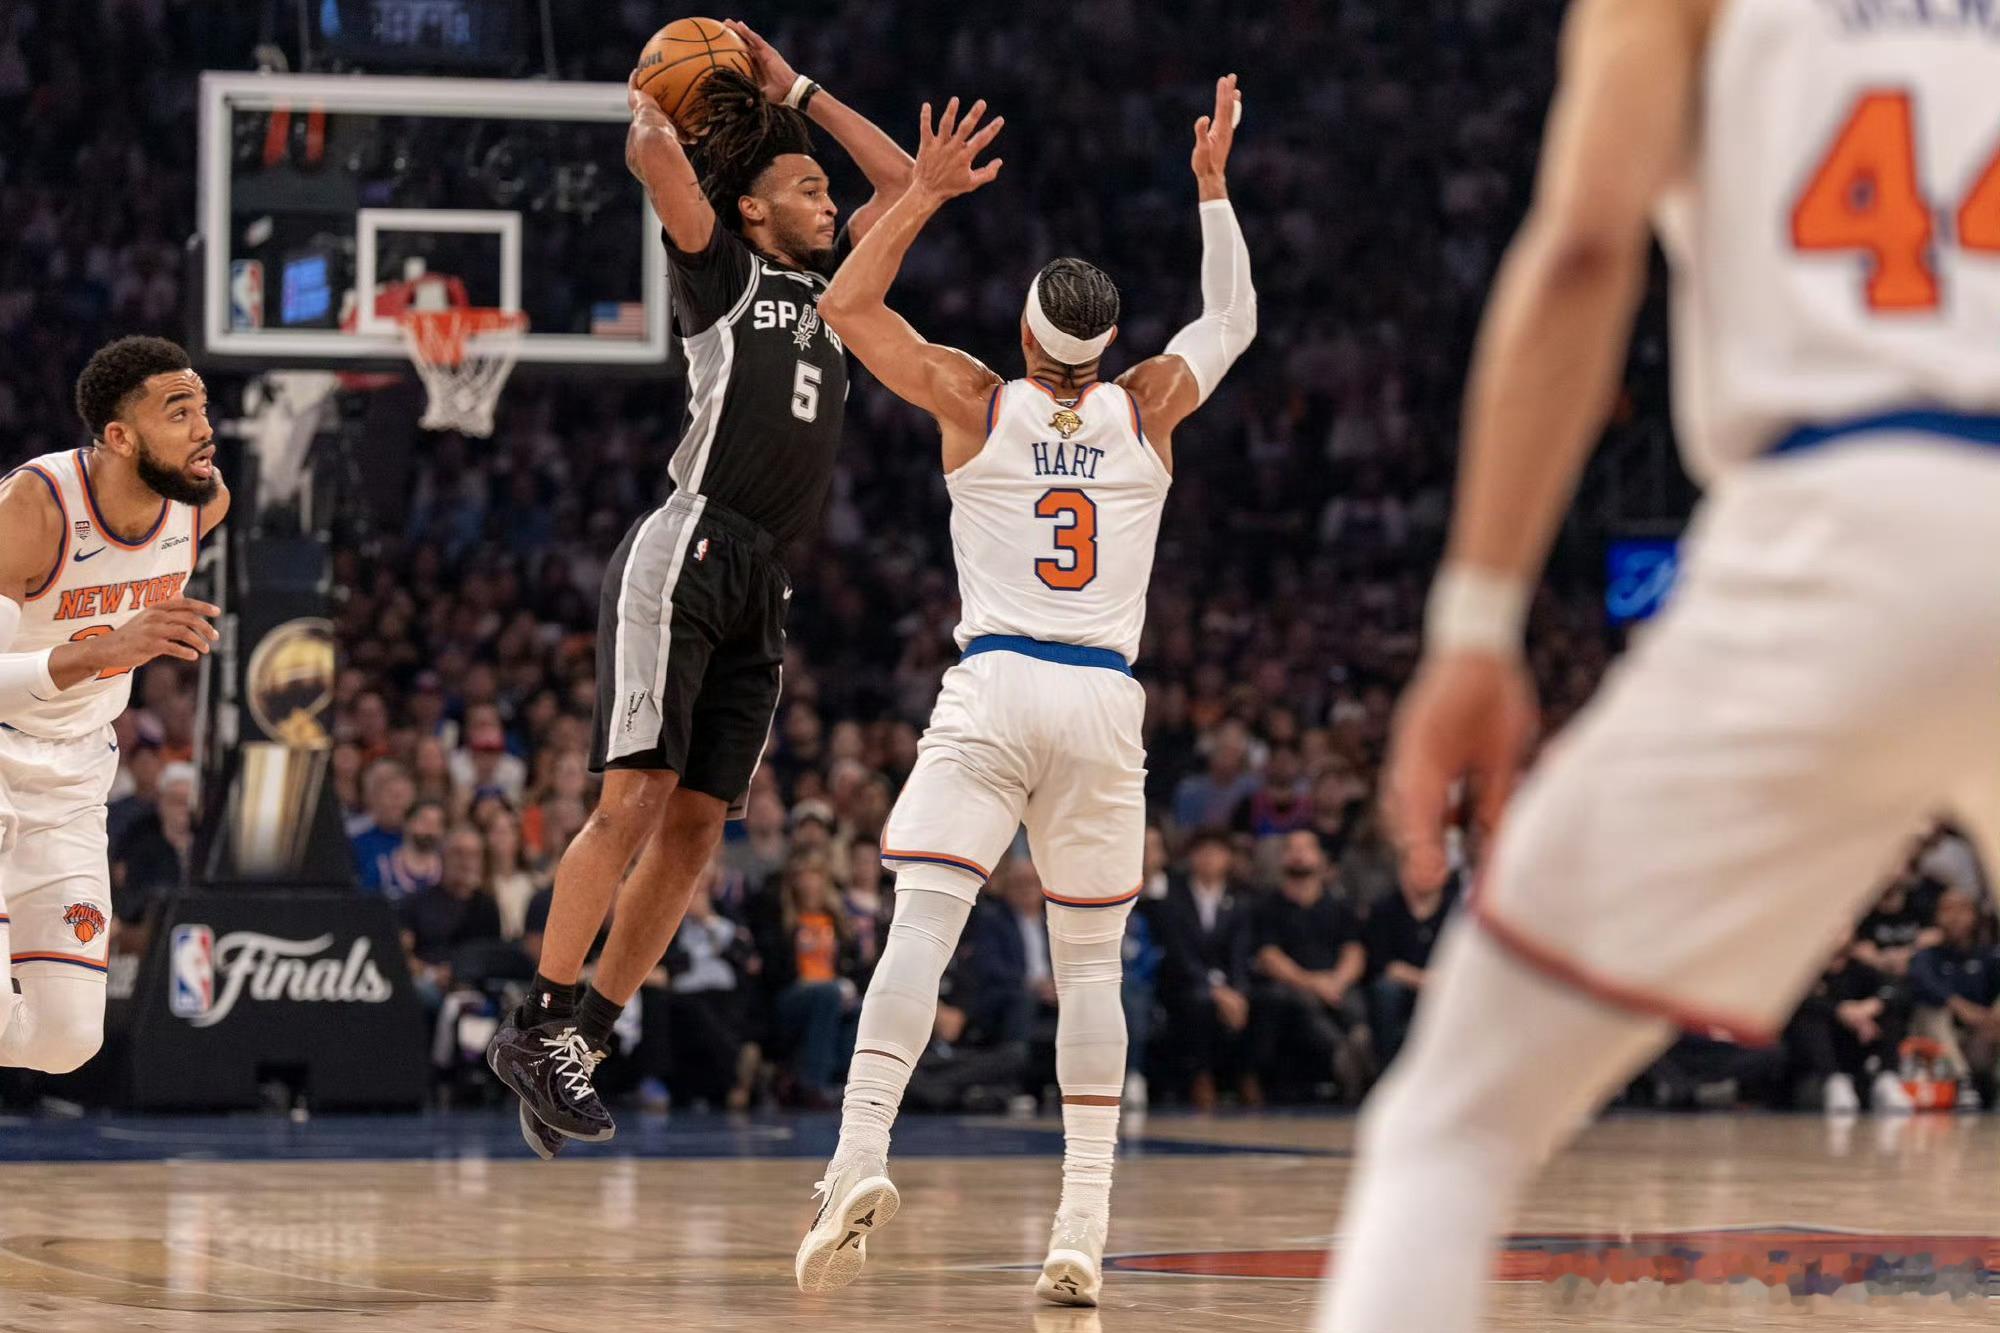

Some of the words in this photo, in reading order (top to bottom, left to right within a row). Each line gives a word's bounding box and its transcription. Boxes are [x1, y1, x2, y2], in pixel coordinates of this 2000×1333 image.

[790, 359, 823, 424] 5
[1031, 441, 1105, 480] HART
[1034, 487, 1098, 592] 3
[53, 582, 128, 621] NEW
[128, 571, 188, 611] YORK
[190, 930, 393, 1028] Finals
